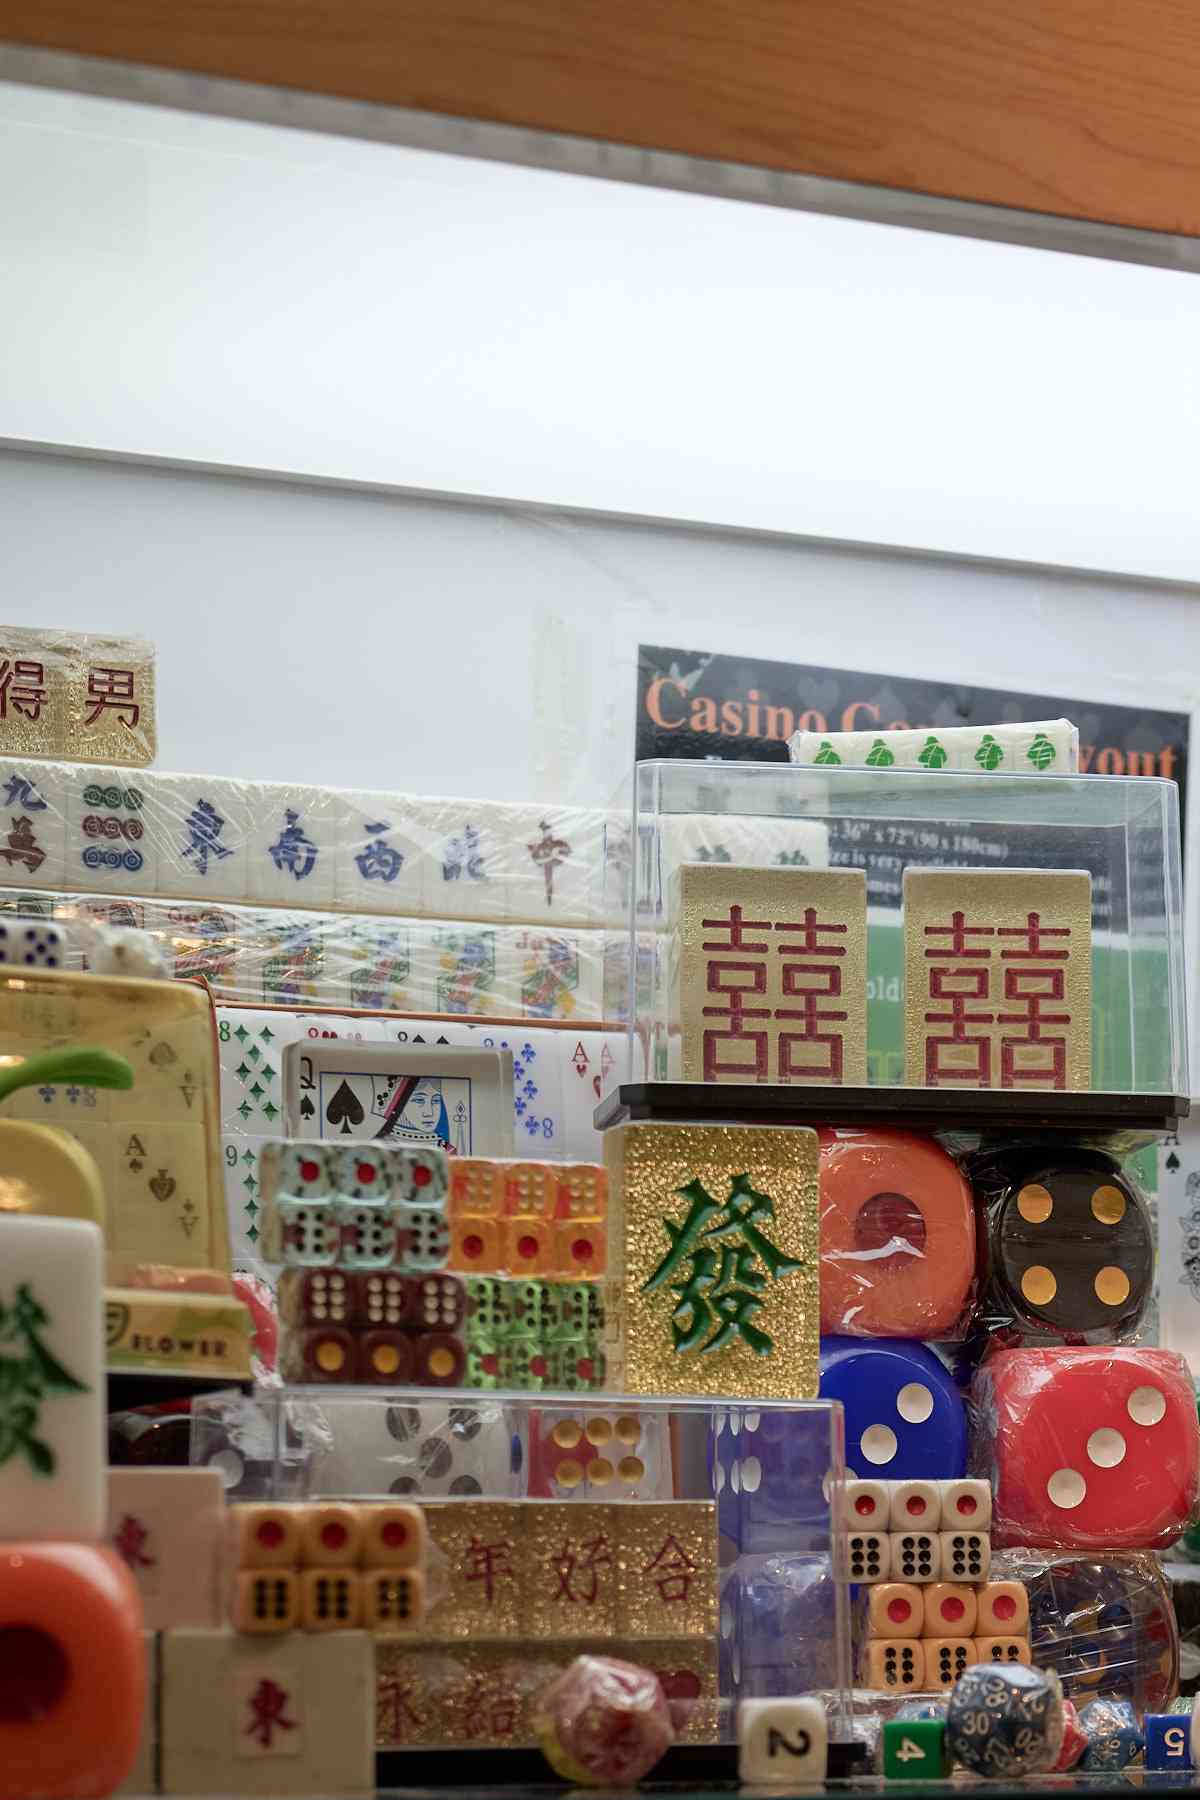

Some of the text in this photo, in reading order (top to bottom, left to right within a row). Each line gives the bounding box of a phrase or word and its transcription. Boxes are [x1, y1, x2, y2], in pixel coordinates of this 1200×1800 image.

[0, 660, 139, 729] 得男
[645, 676, 827, 741] Casino
[181, 798, 235, 875] 東
[268, 808, 319, 880] 南
[355, 822, 404, 882] 西
[642, 1172, 806, 1357] 發
[463, 1534, 699, 1603] 年好合
[243, 1678, 297, 1748] 東
[962, 1712, 990, 1736] 30
[895, 1738, 926, 1762] 4
